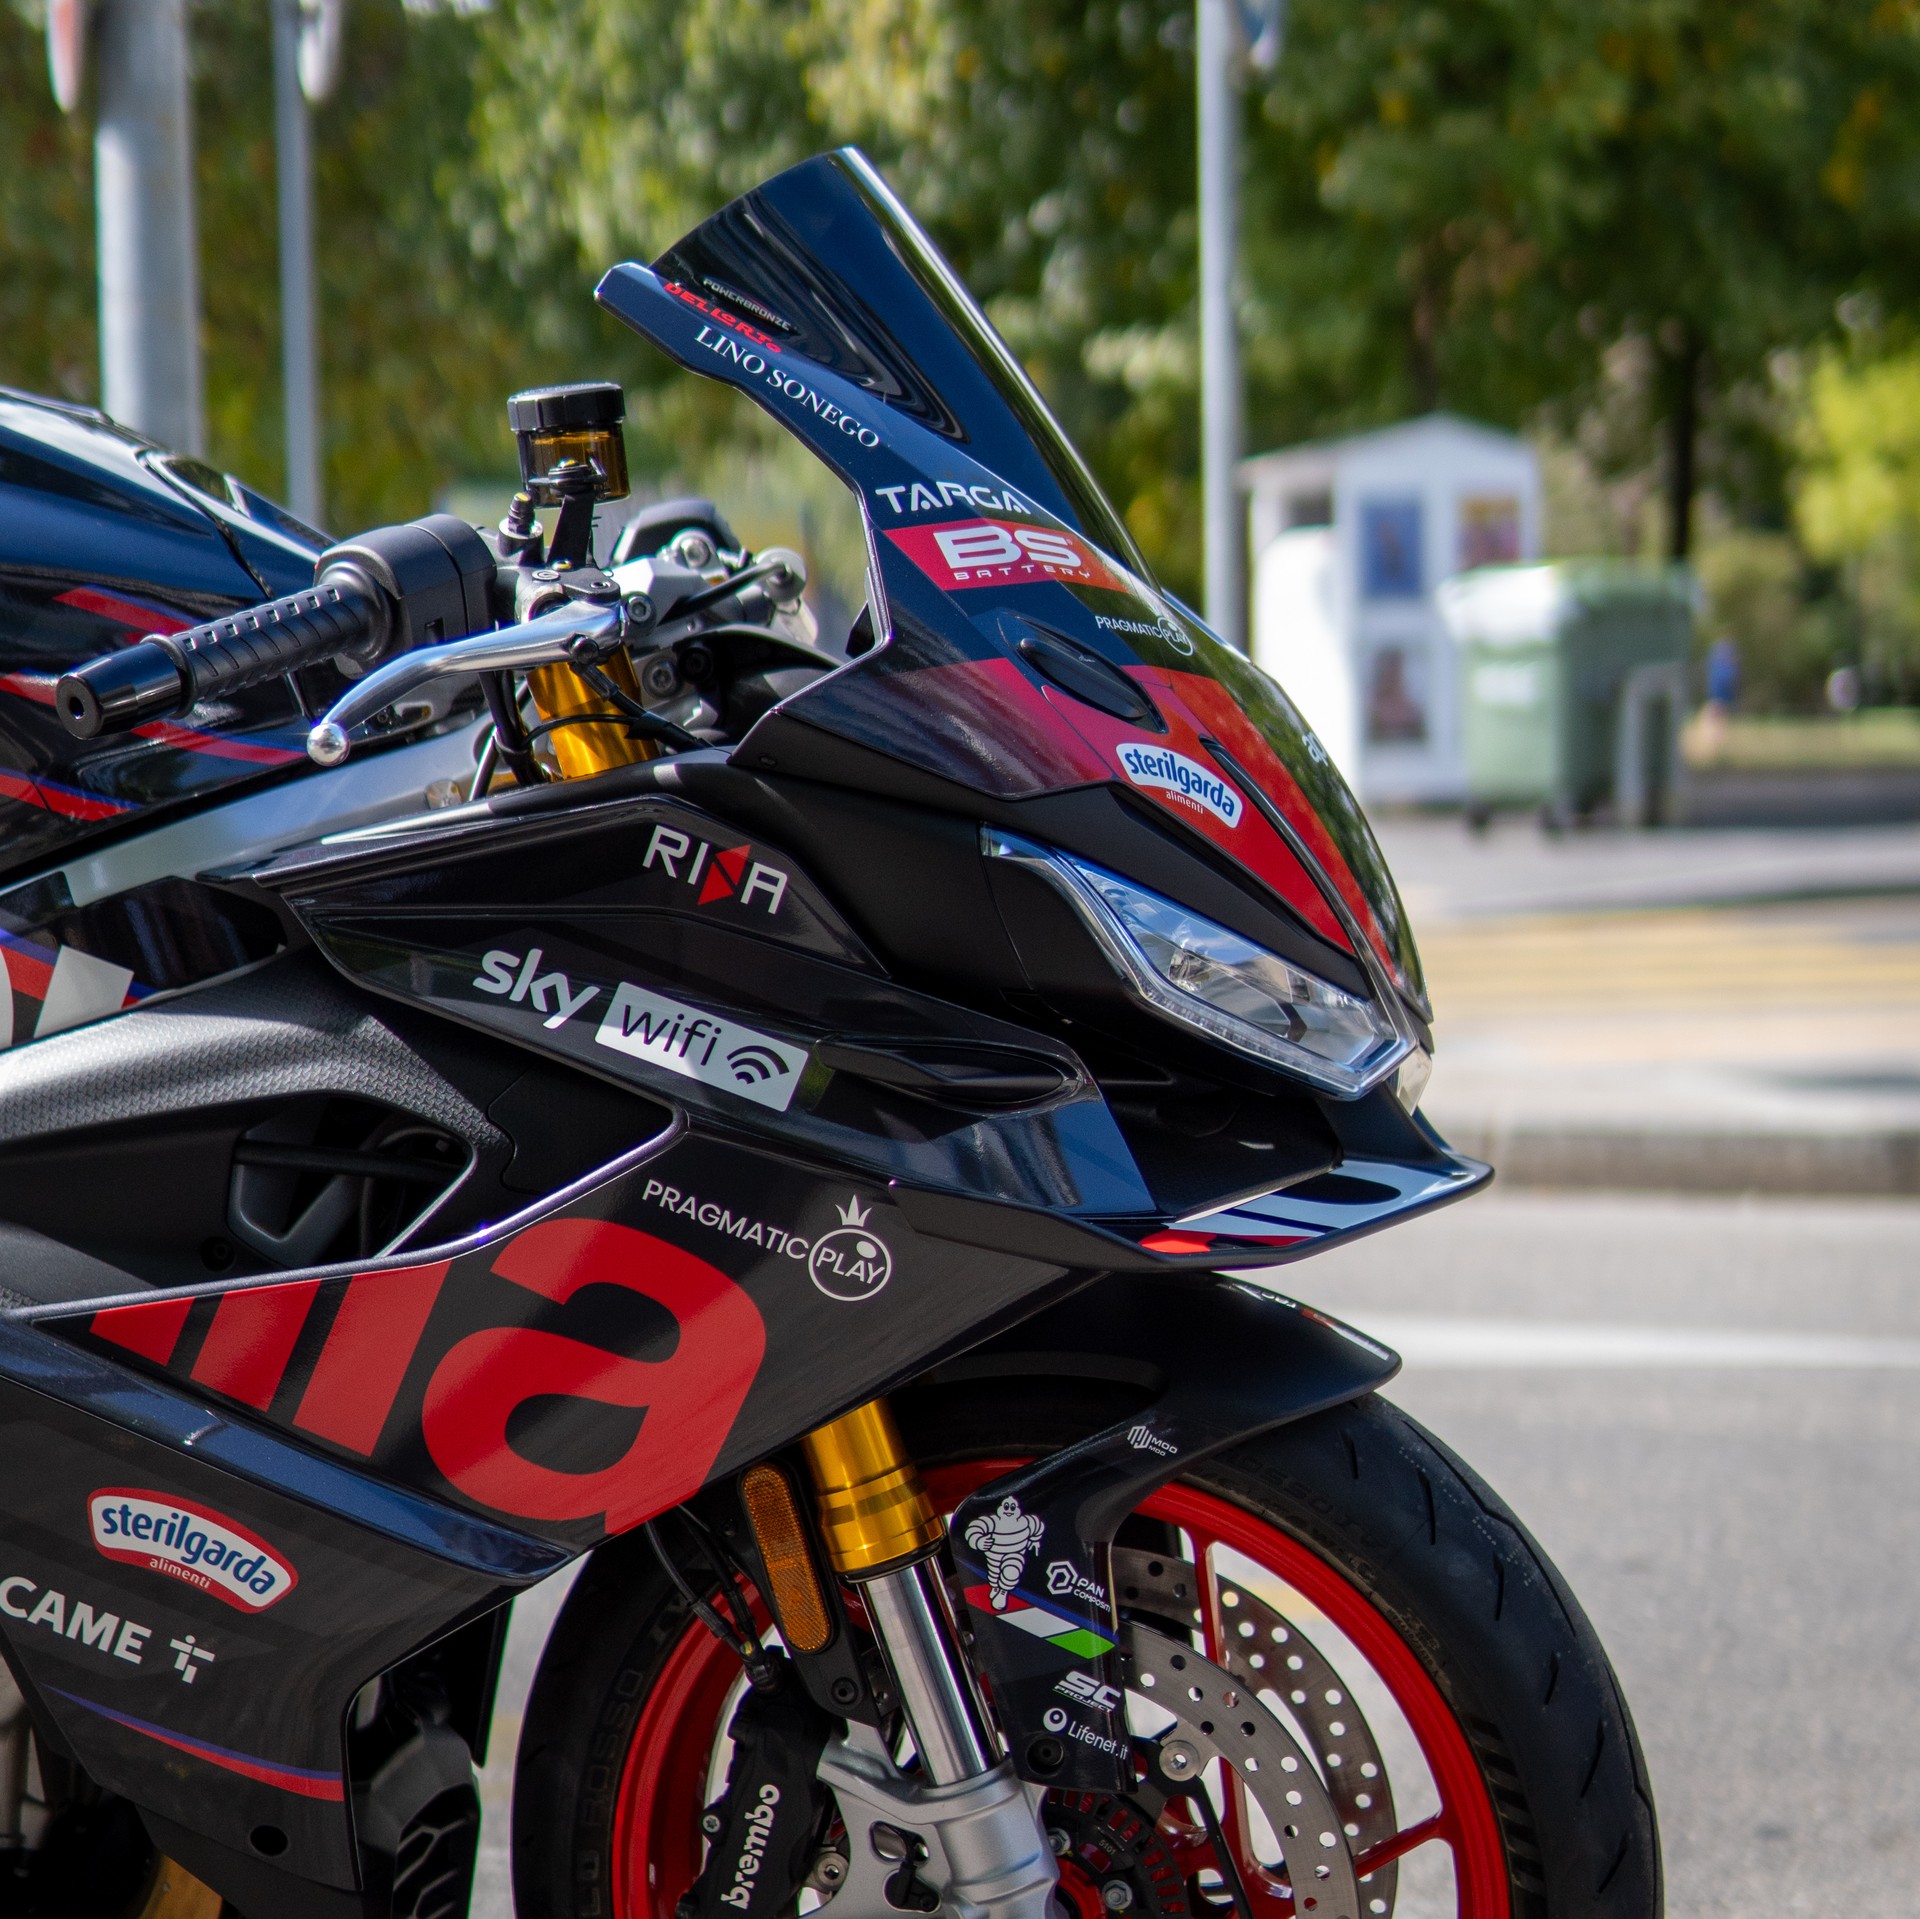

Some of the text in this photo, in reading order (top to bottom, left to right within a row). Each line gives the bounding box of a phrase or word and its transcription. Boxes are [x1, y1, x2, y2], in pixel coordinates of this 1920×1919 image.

[703, 278, 791, 331] POWERBRONZE
[694, 325, 880, 448] LINO SONEGO
[875, 481, 1031, 515] TARGA
[933, 525, 1082, 569] BS
[953, 564, 1091, 581] BATTERY
[1094, 615, 1163, 638] PRAGMATIC
[1124, 748, 1235, 818] sterilgarda
[1165, 789, 1204, 815] alimenti
[472, 948, 723, 1067] sky wifi
[641, 1178, 886, 1285] PRAGMATIC PLAY
[101, 1503, 276, 1595] sterilgarda
[149, 1557, 212, 1590] alimenti
[1077, 1576, 1105, 1599] PAN
[0, 1576, 152, 1665] CAME
[1052, 1684, 1114, 1713] PROJECT
[1058, 1670, 1122, 1710] SC
[1067, 1720, 1129, 1760] Lifenet.it
[720, 1783, 781, 1910] brembo
